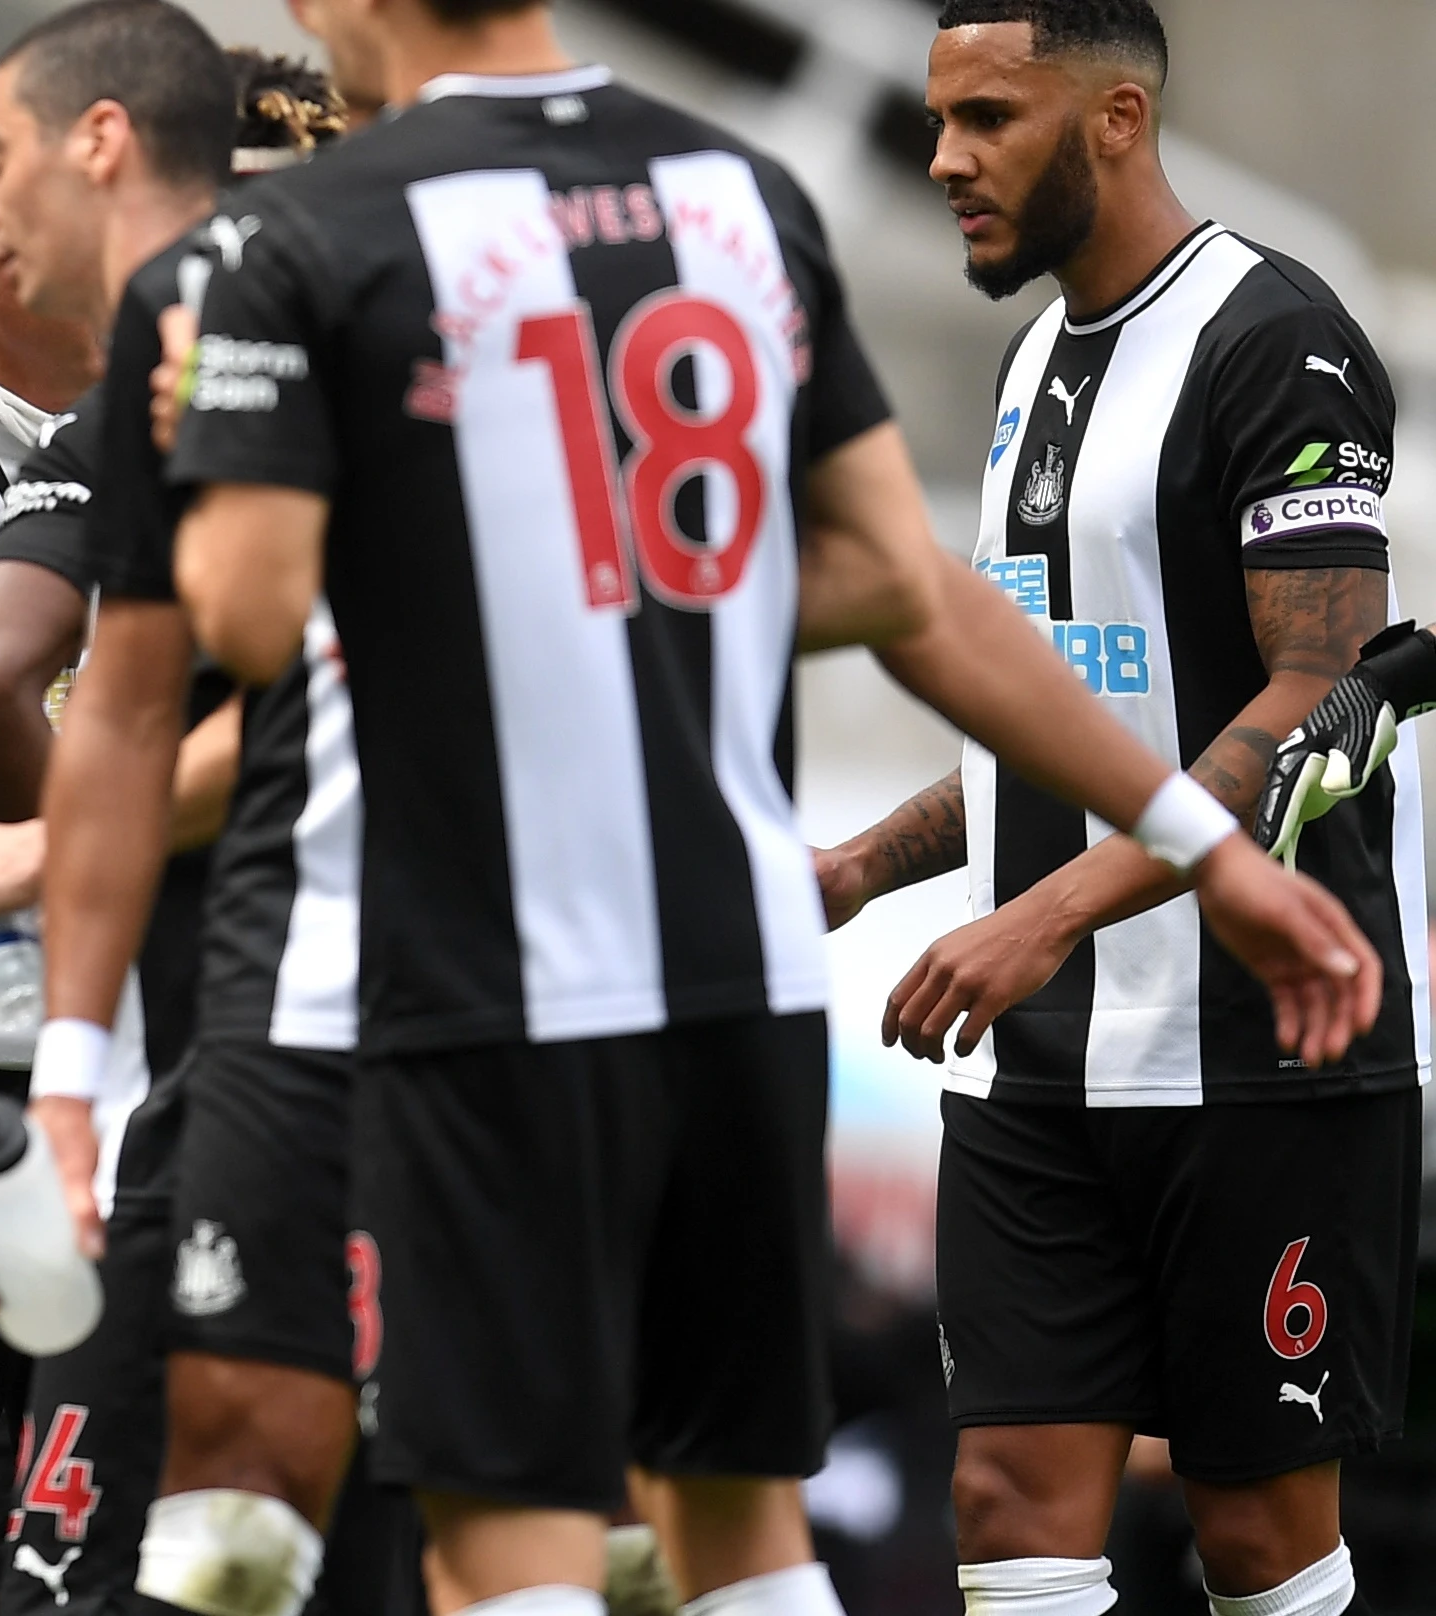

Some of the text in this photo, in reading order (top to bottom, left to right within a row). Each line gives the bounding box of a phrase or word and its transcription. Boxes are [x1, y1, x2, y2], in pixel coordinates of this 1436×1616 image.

[508, 183, 665, 258] LIVES
[514, 286, 767, 616] 18
[1281, 493, 1380, 521] Captai
[1053, 624, 1150, 694] 88
[1263, 1236, 1328, 1360] 6
